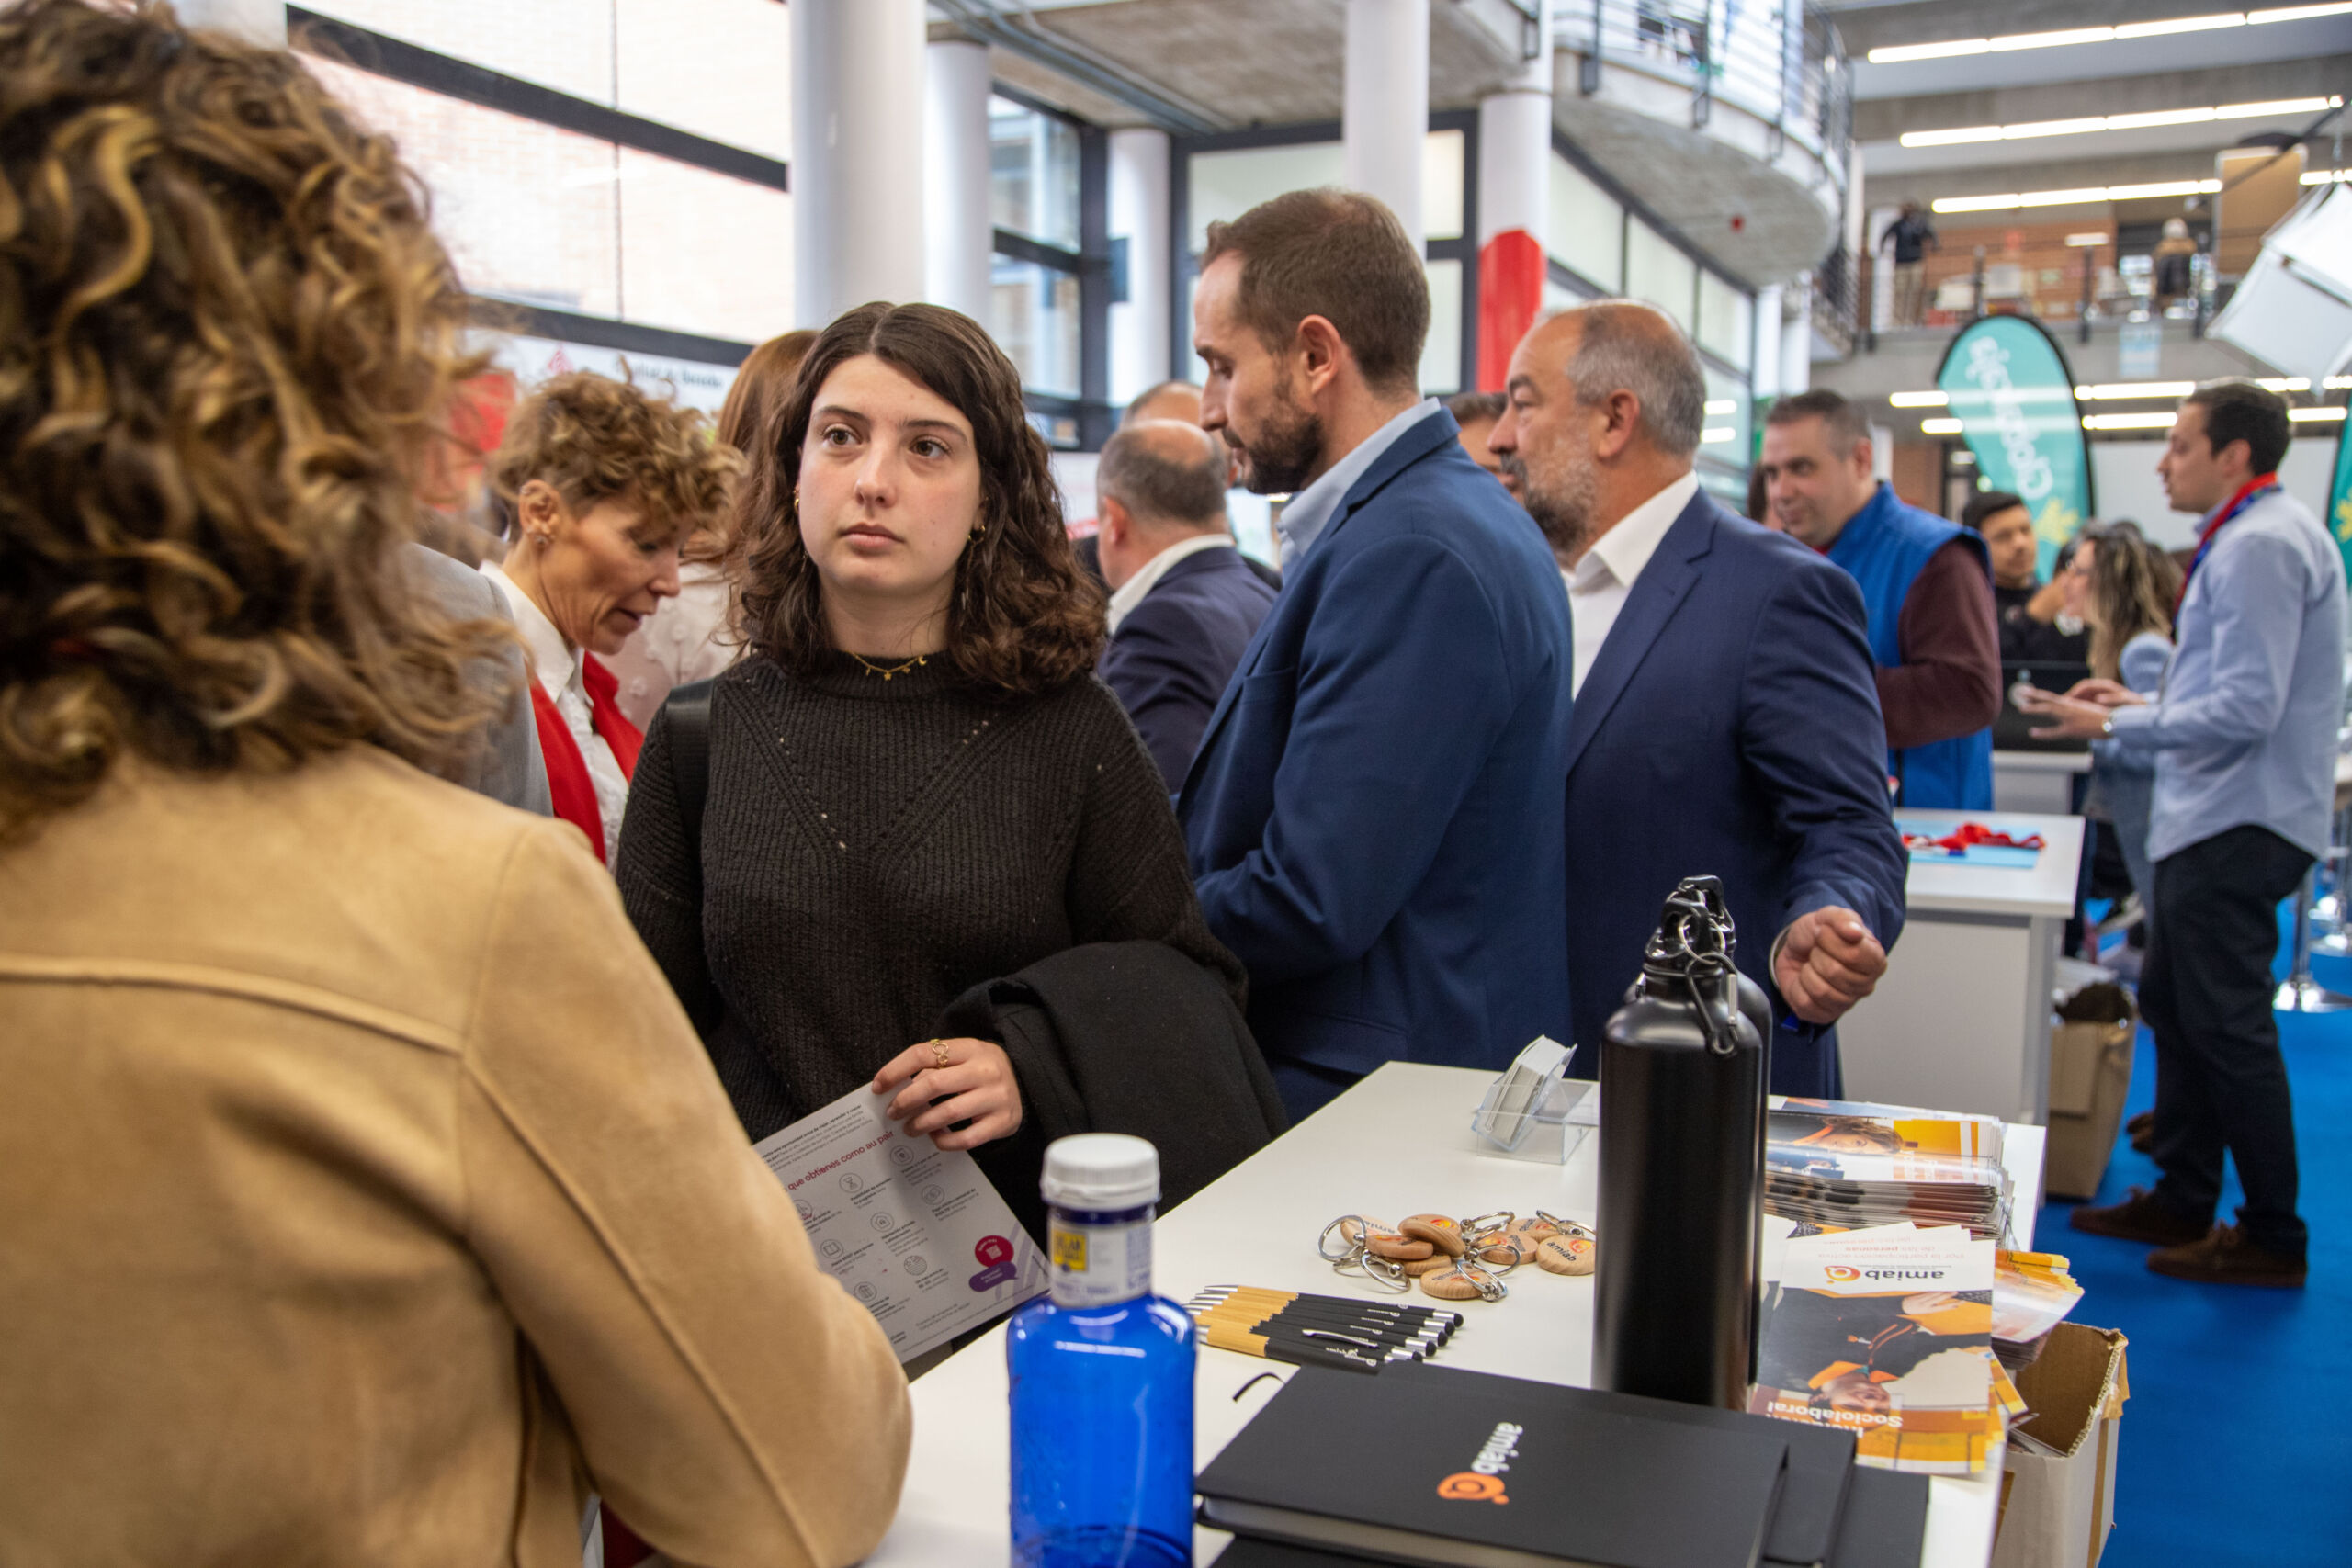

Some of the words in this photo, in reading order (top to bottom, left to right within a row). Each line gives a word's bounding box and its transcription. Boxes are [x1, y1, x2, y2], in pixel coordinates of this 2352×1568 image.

[787, 1178, 805, 1190] que
[805, 1158, 841, 1181] obtienes
[841, 1145, 865, 1163] como
[865, 1140, 876, 1150] au
[876, 1130, 894, 1145] pair
[1546, 1241, 1577, 1261] amiab
[1865, 1270, 1945, 1281] amiab
[1767, 1400, 1904, 1428] Sociolaboral
[1470, 1421, 1523, 1475] amiab
